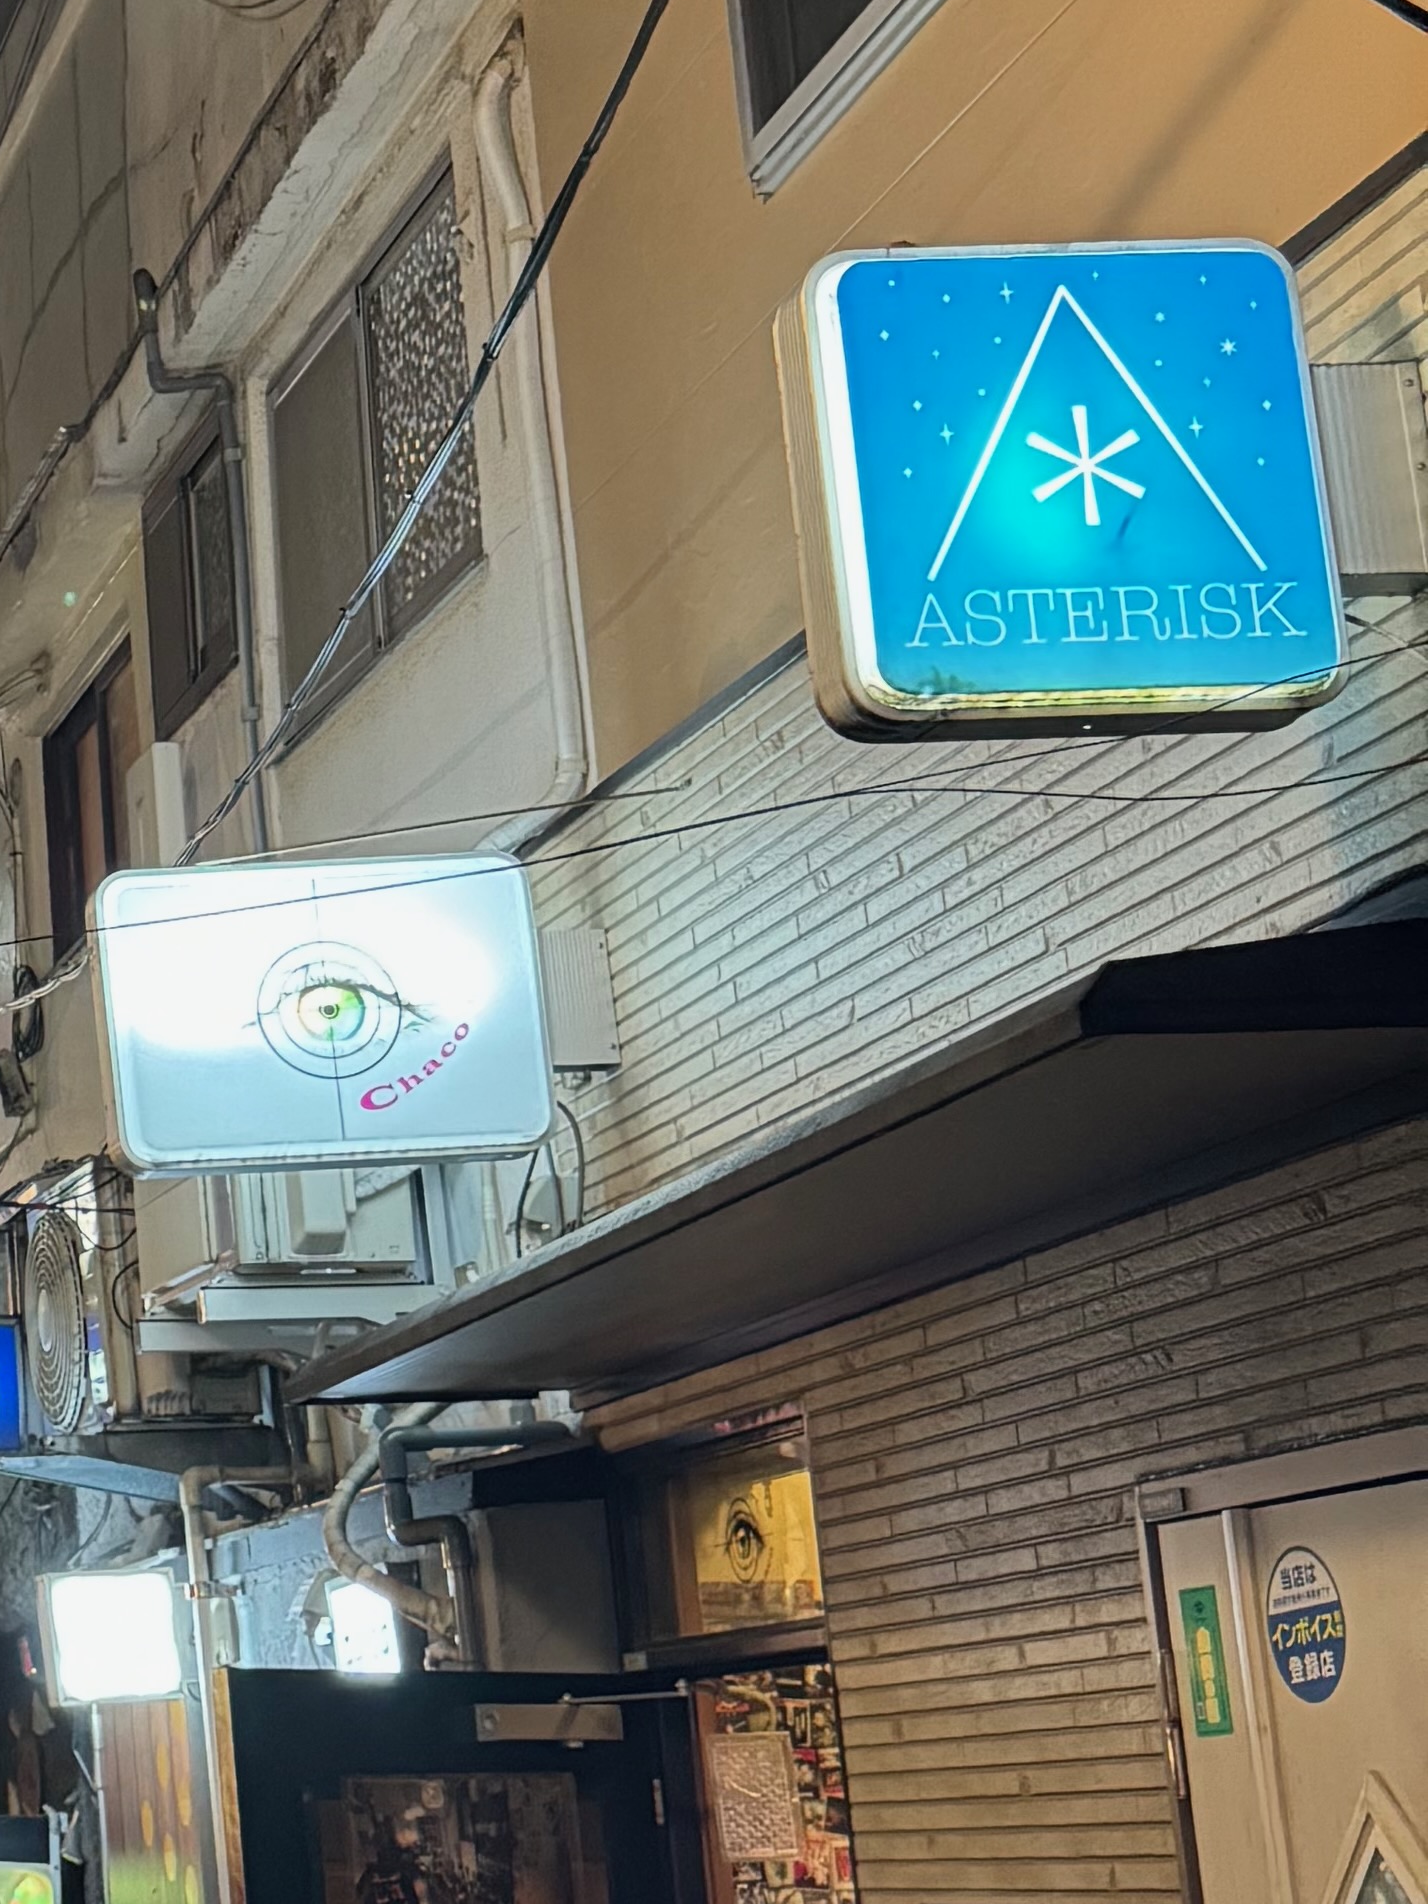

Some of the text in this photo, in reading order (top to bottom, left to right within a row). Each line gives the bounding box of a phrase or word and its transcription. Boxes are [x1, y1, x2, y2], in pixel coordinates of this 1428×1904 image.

[906, 580, 1307, 649] ASTERISK
[358, 1020, 473, 1112] Chaco
[1280, 1561, 1317, 1590] 当店は
[1272, 1613, 1334, 1651] インボイス
[1288, 1649, 1337, 1684] 登録店
